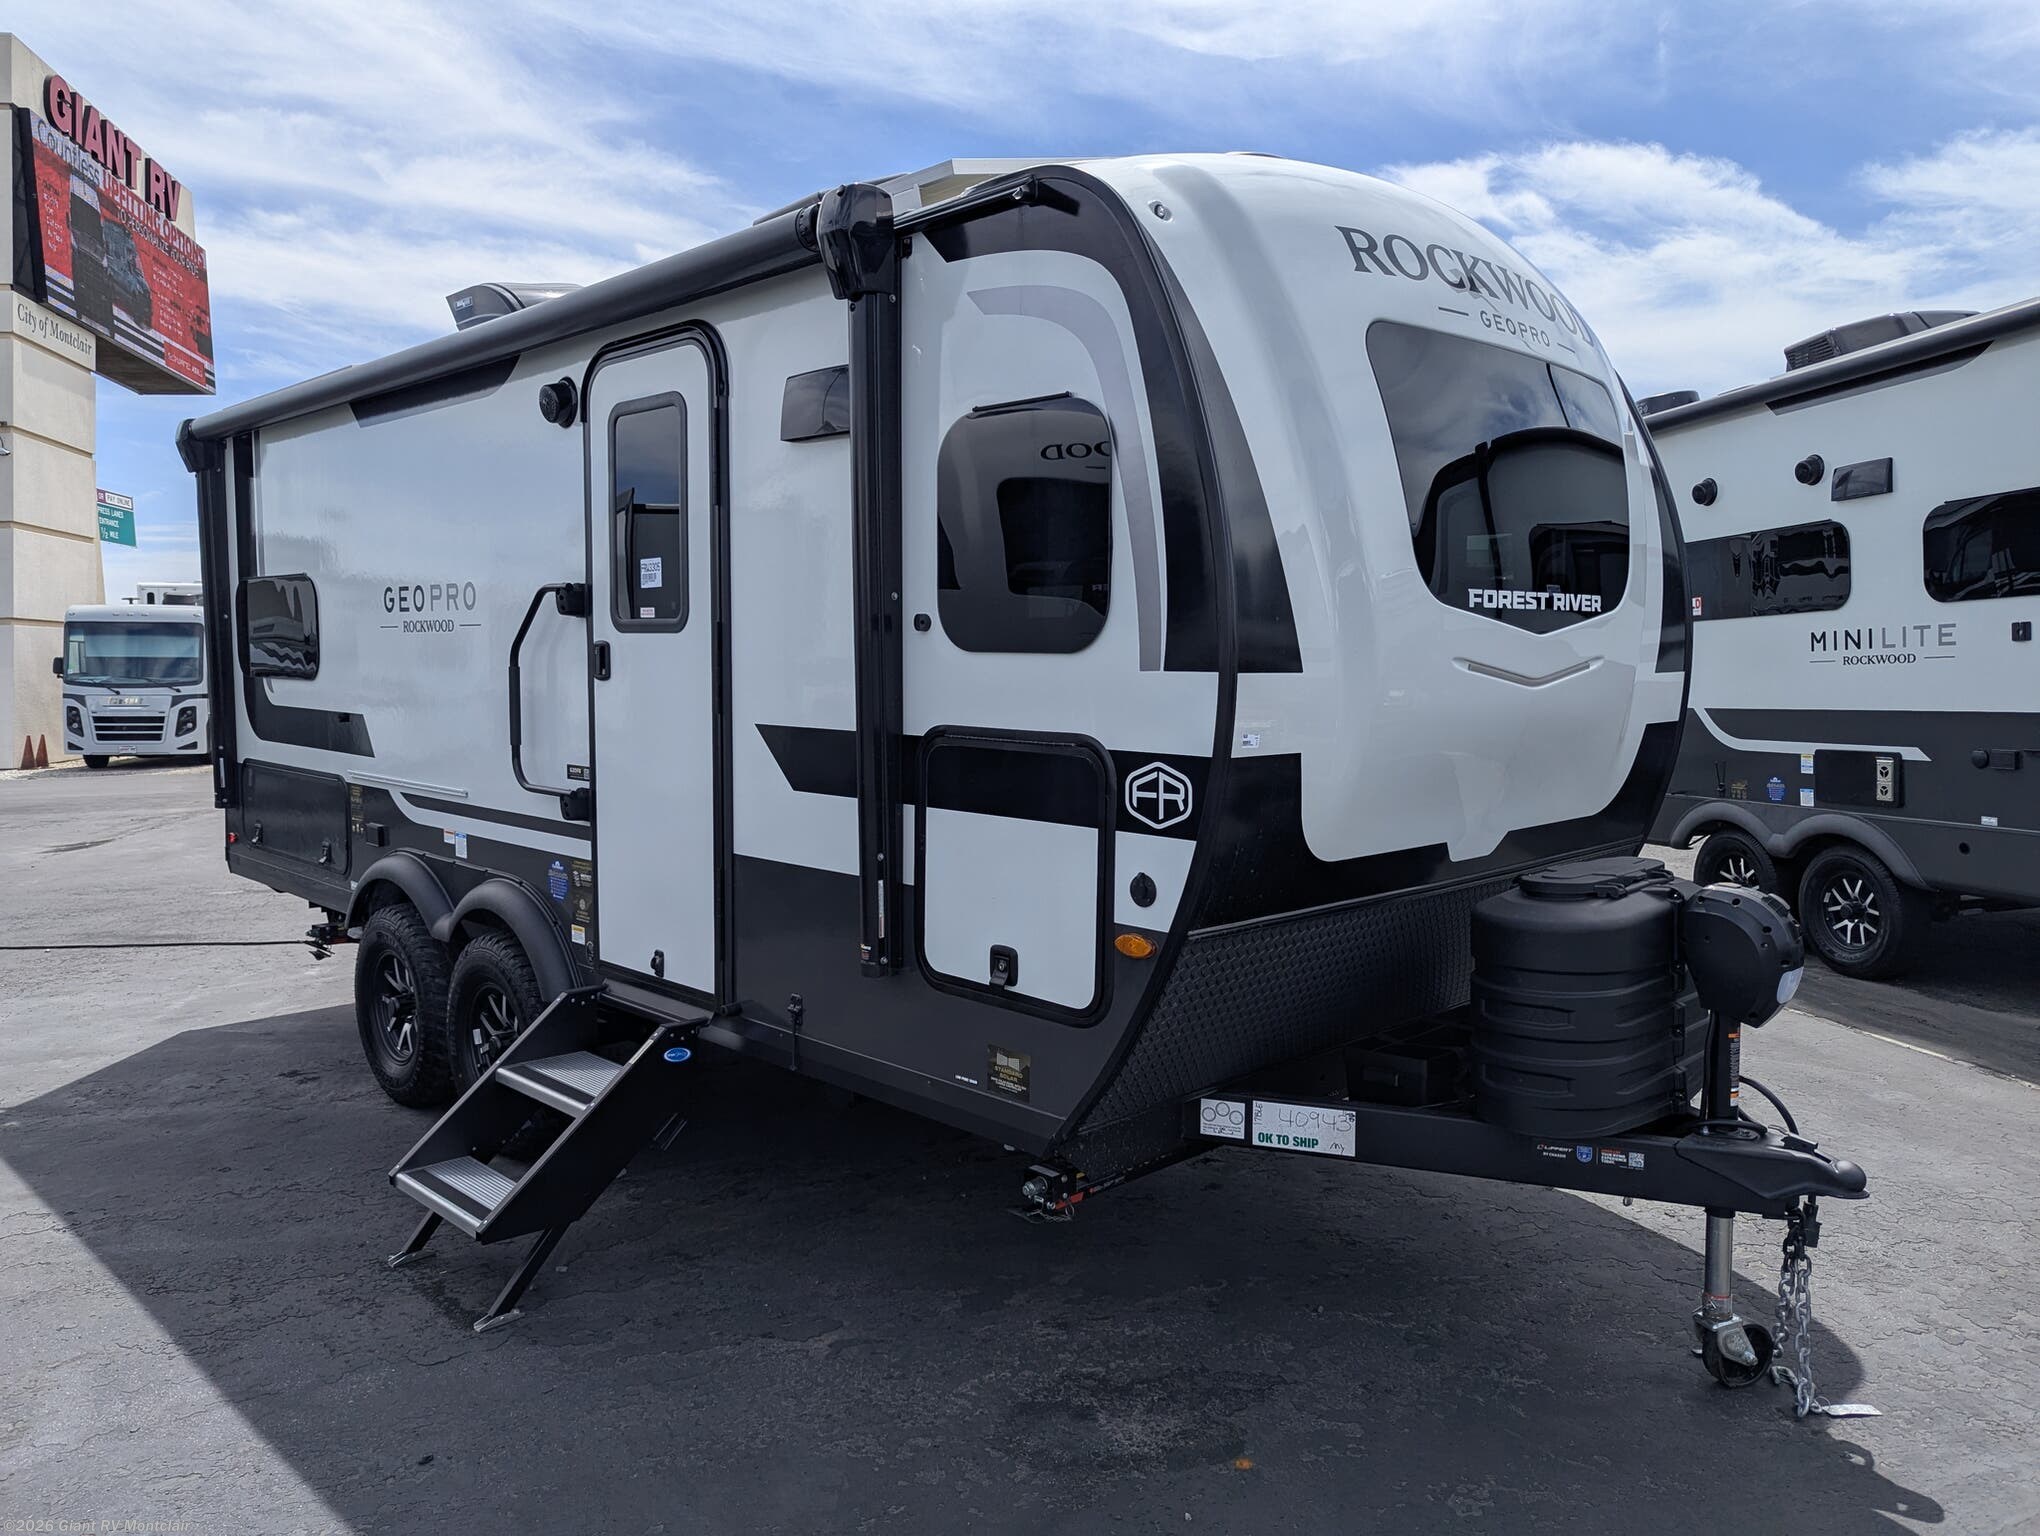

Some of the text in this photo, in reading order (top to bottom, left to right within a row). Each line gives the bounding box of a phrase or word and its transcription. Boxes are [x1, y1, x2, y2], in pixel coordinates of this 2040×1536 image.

[43, 74, 142, 190] GIANT
[145, 158, 181, 222] RV
[38, 120, 100, 188] Countless
[162, 217, 206, 268] OPTIONS
[1334, 225, 1594, 348] ROCKWOOD
[17, 303, 92, 356] City of Montclair
[1480, 309, 1551, 348] GEOPRO
[384, 581, 476, 613] GEOPRO
[1468, 588, 1602, 612] FOREST RIVER
[403, 620, 454, 633] ROCKWOOD
[1810, 623, 1957, 652] MINILITE
[1843, 653, 1916, 666] ROCKWOOD
[1278, 1107, 1352, 1132] 40943
[1257, 1132, 1319, 1149] OK TO SHIP
